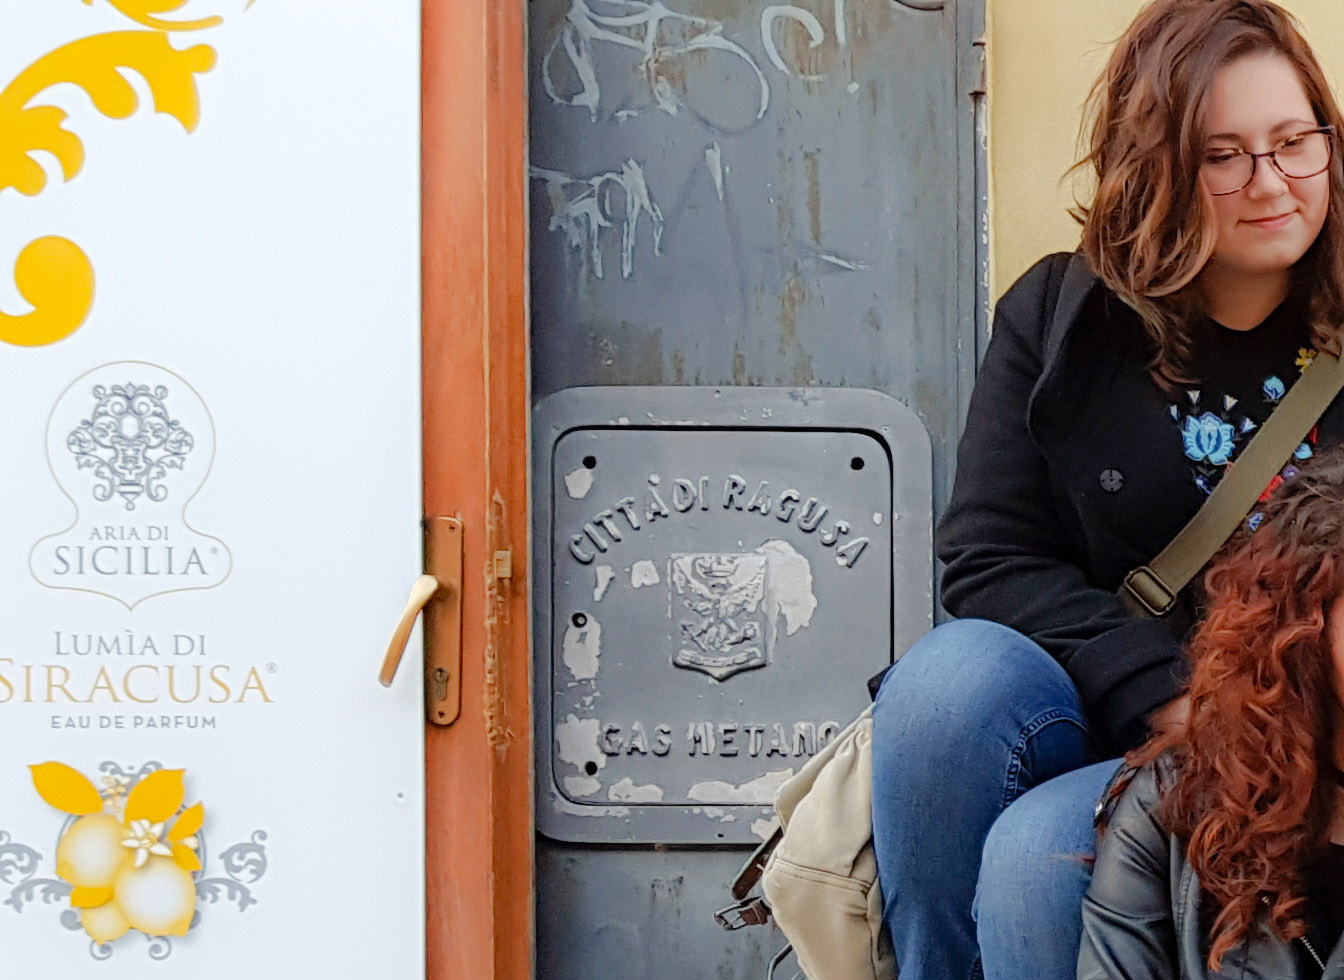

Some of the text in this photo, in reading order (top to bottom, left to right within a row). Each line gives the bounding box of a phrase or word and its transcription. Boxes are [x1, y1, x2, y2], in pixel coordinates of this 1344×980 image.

[88, 525, 170, 541] ARIA DI
[671, 476, 710, 513] DI
[722, 474, 870, 568] RAGUSA
[53, 545, 210, 576] SICILIA
[172, 633, 207, 656] DI
[50, 715, 218, 729] EAU DE PARFUM
[599, 720, 672, 758] GAS
